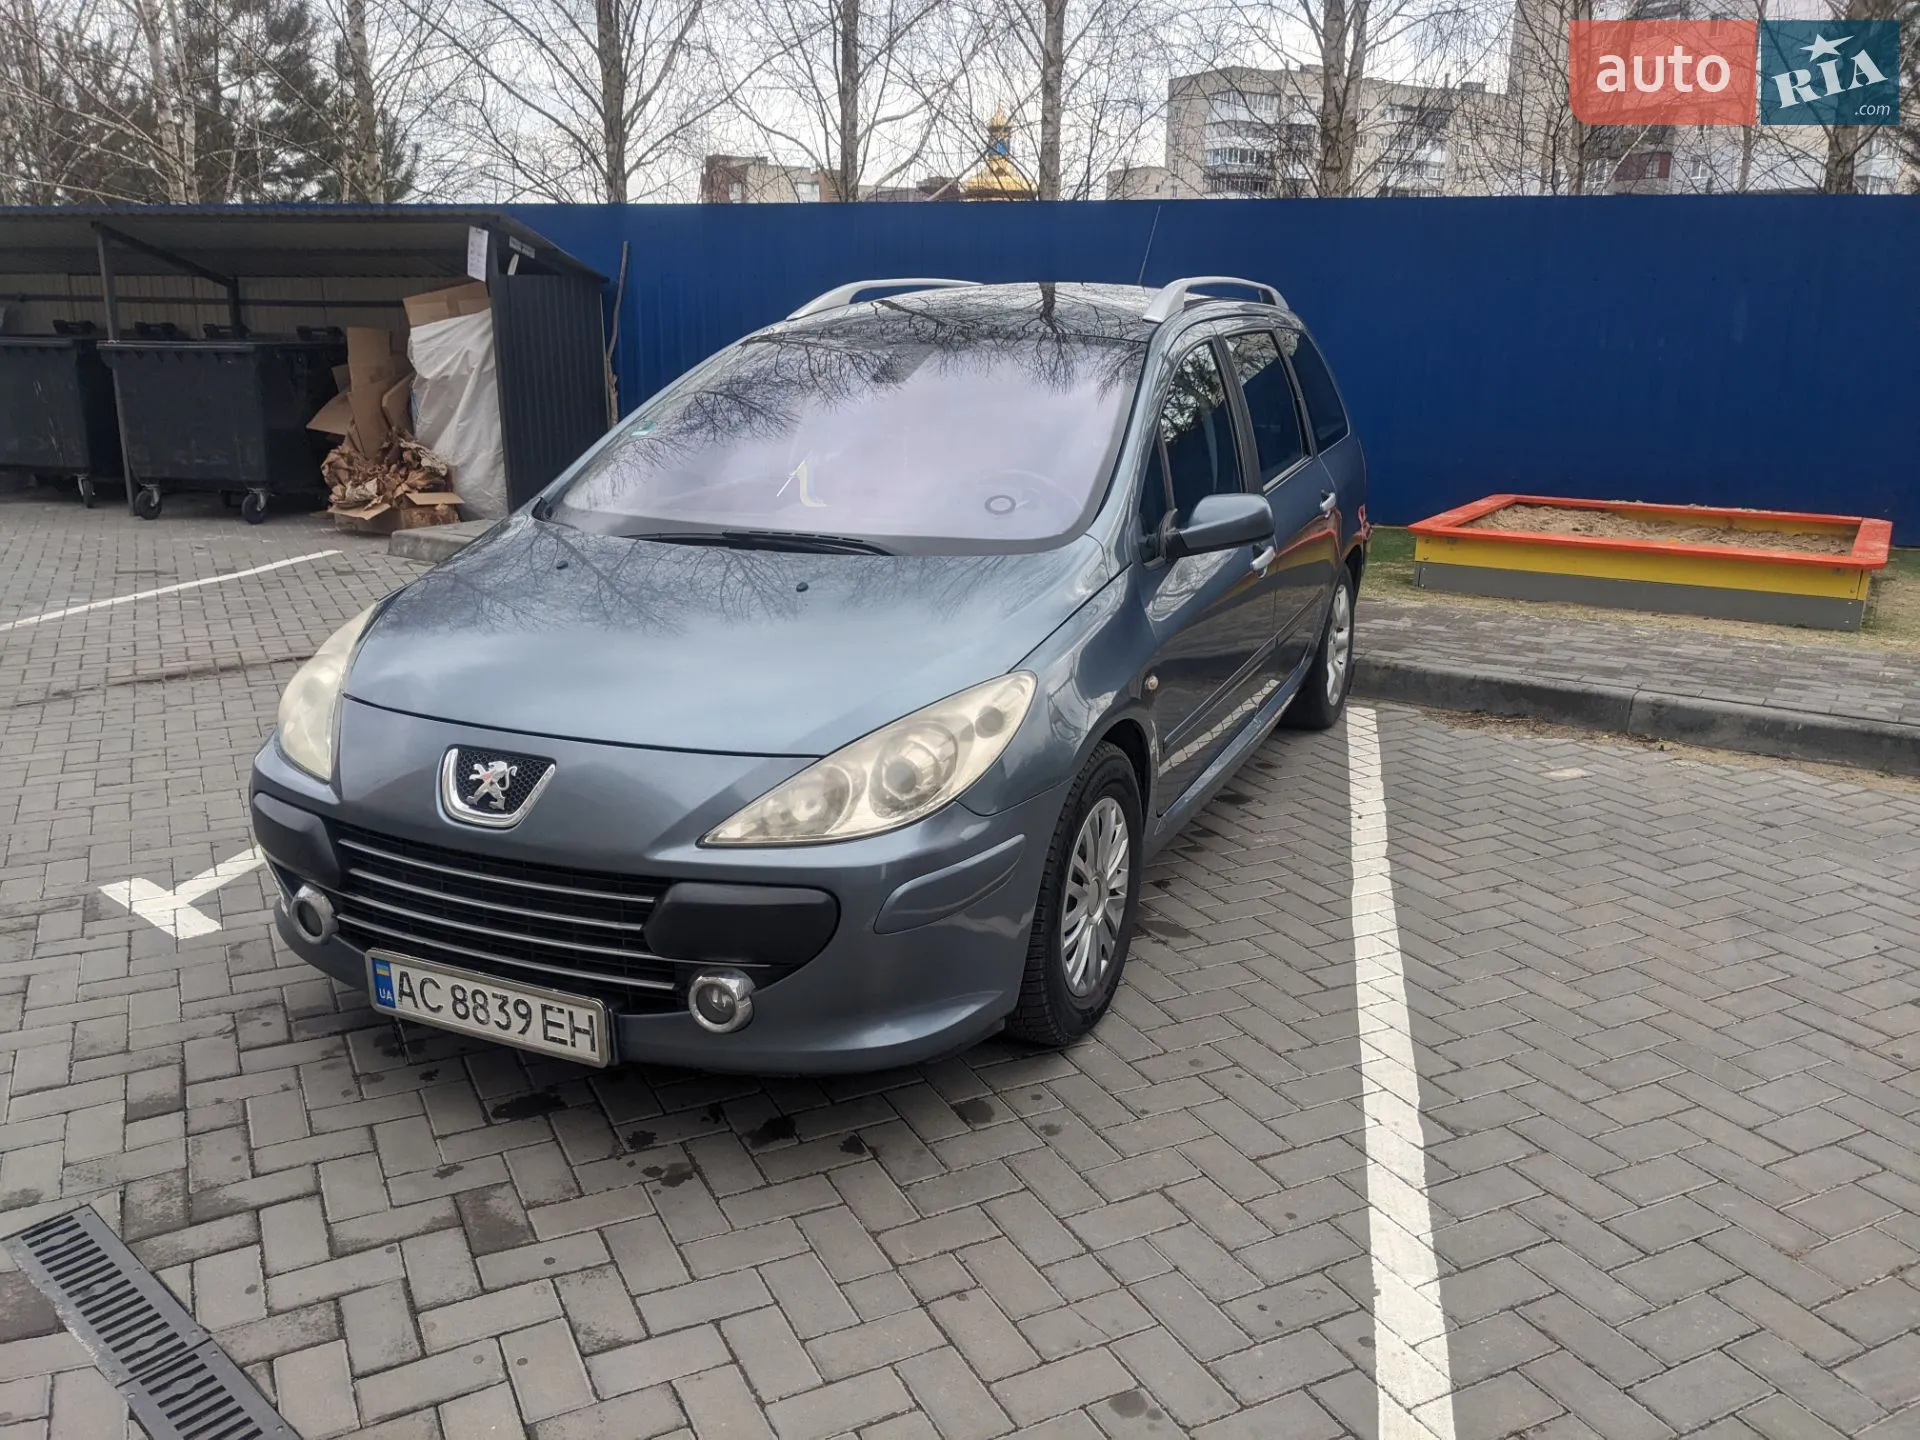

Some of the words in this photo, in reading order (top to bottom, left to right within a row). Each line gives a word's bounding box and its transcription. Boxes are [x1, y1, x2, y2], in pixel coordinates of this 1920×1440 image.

[379, 989, 394, 1002] UA
[398, 971, 444, 1013] AC
[450, 984, 532, 1034] 8839
[541, 1003, 596, 1052] EH
